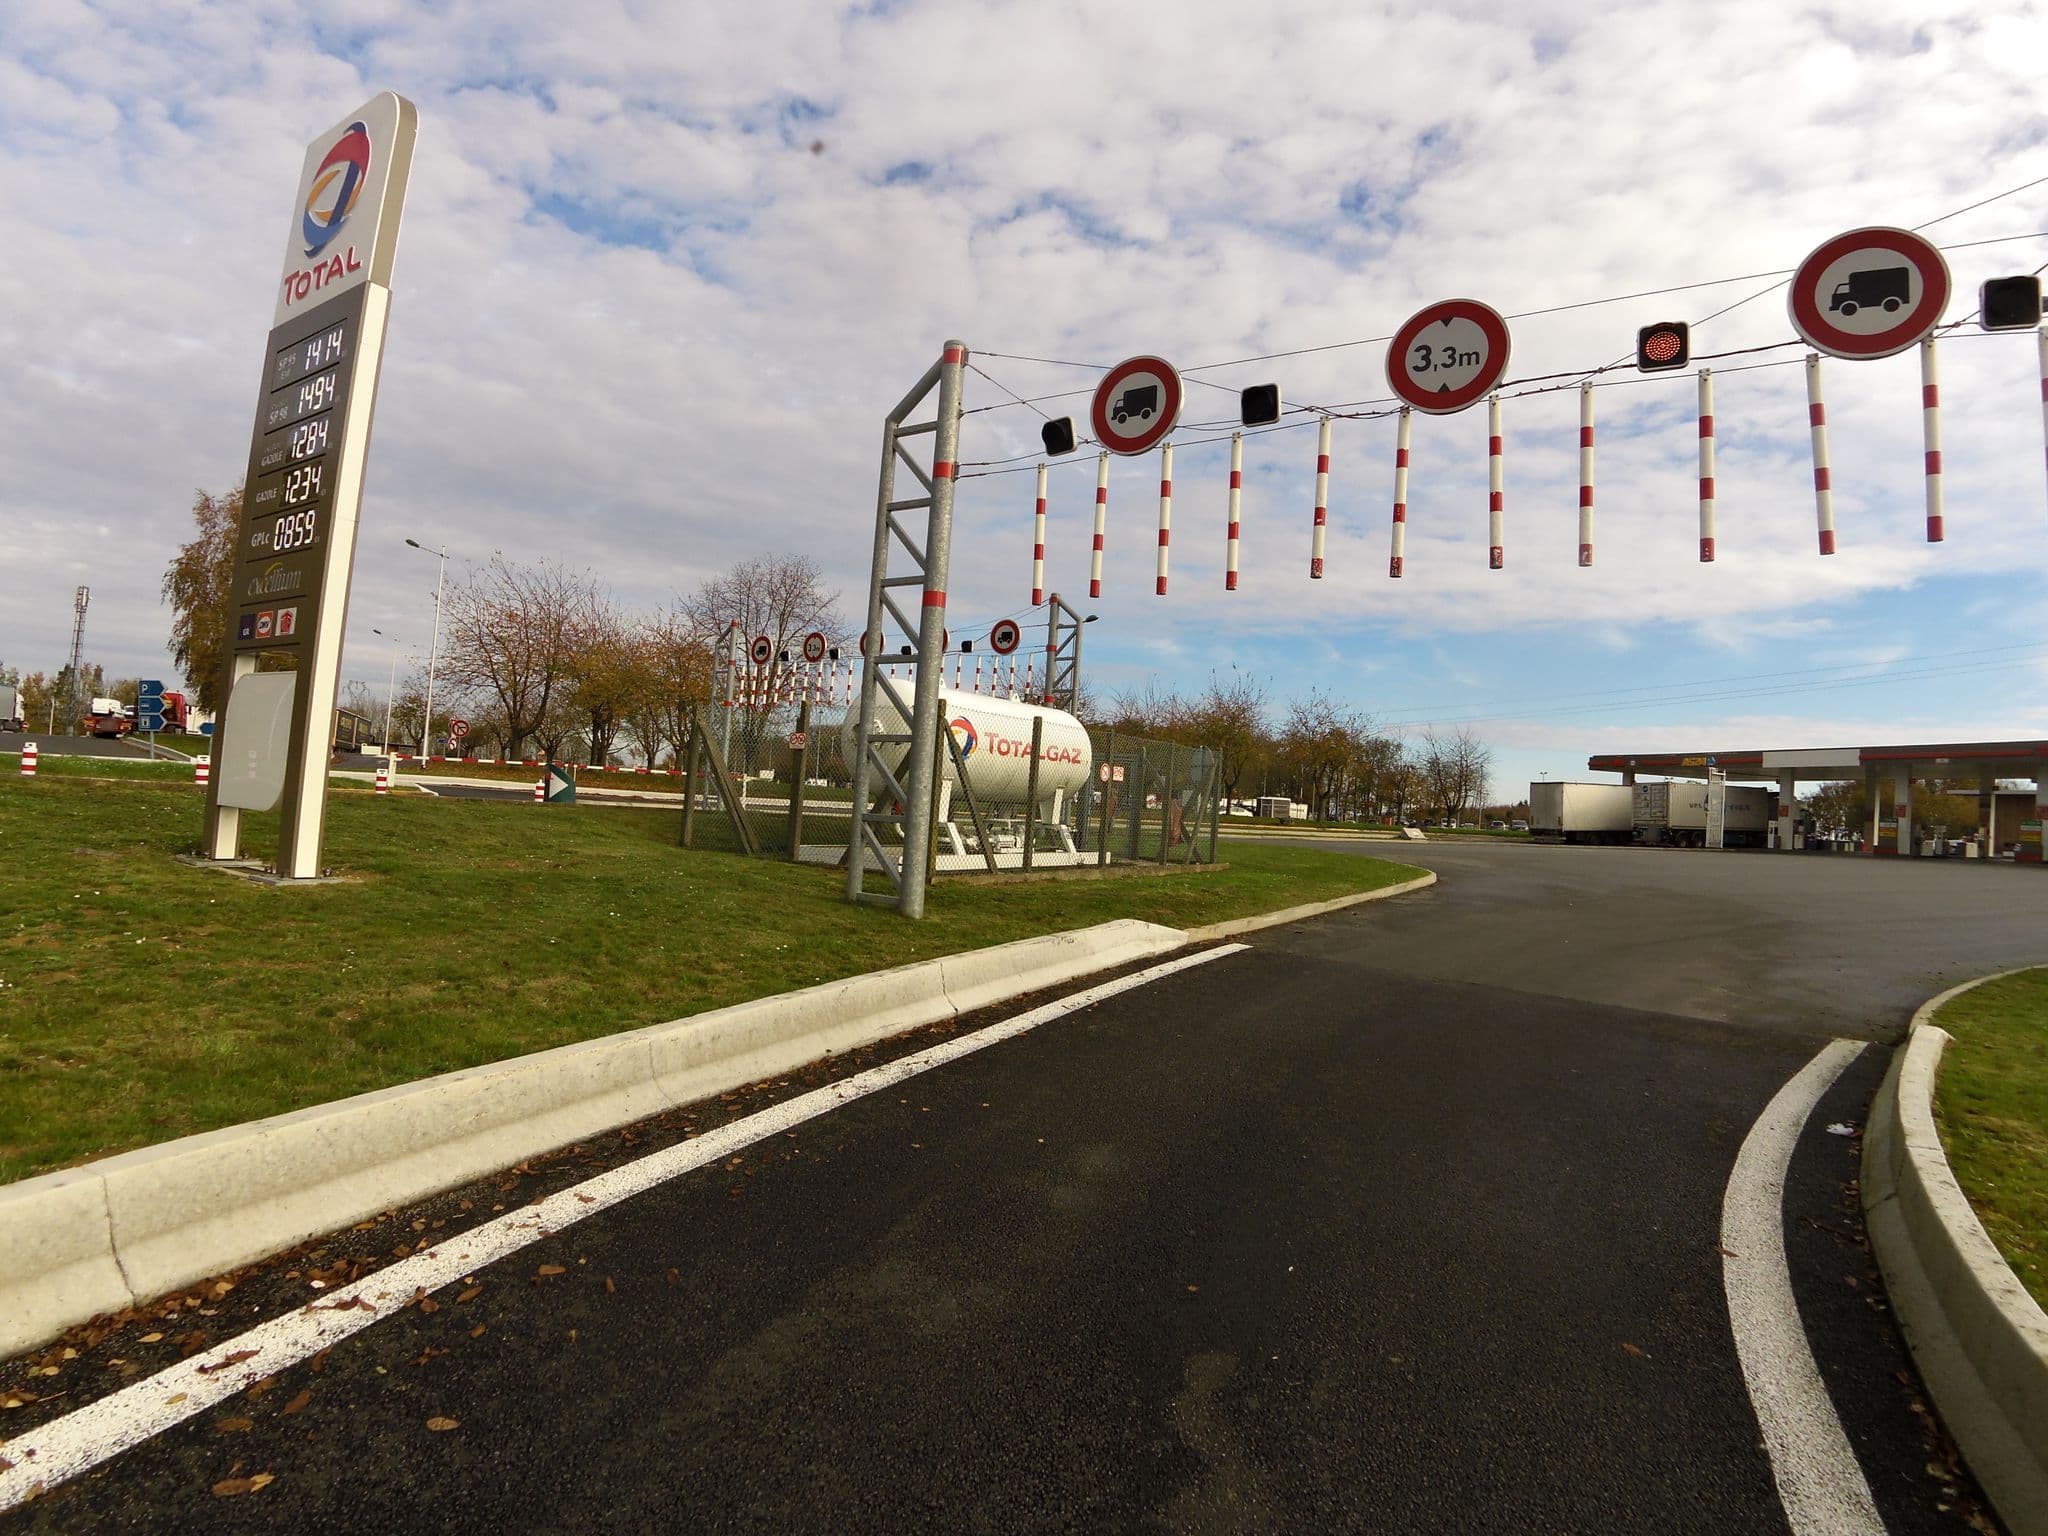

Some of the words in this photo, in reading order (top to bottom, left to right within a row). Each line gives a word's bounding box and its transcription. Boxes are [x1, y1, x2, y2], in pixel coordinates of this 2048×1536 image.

[284, 246, 362, 306] TOTAL
[305, 329, 343, 370] 1414
[1411, 344, 1481, 373] 3,3m
[298, 373, 336, 414] 1494
[291, 419, 329, 459] 1284
[284, 465, 322, 503] 1234
[273, 509, 316, 551] 0859
